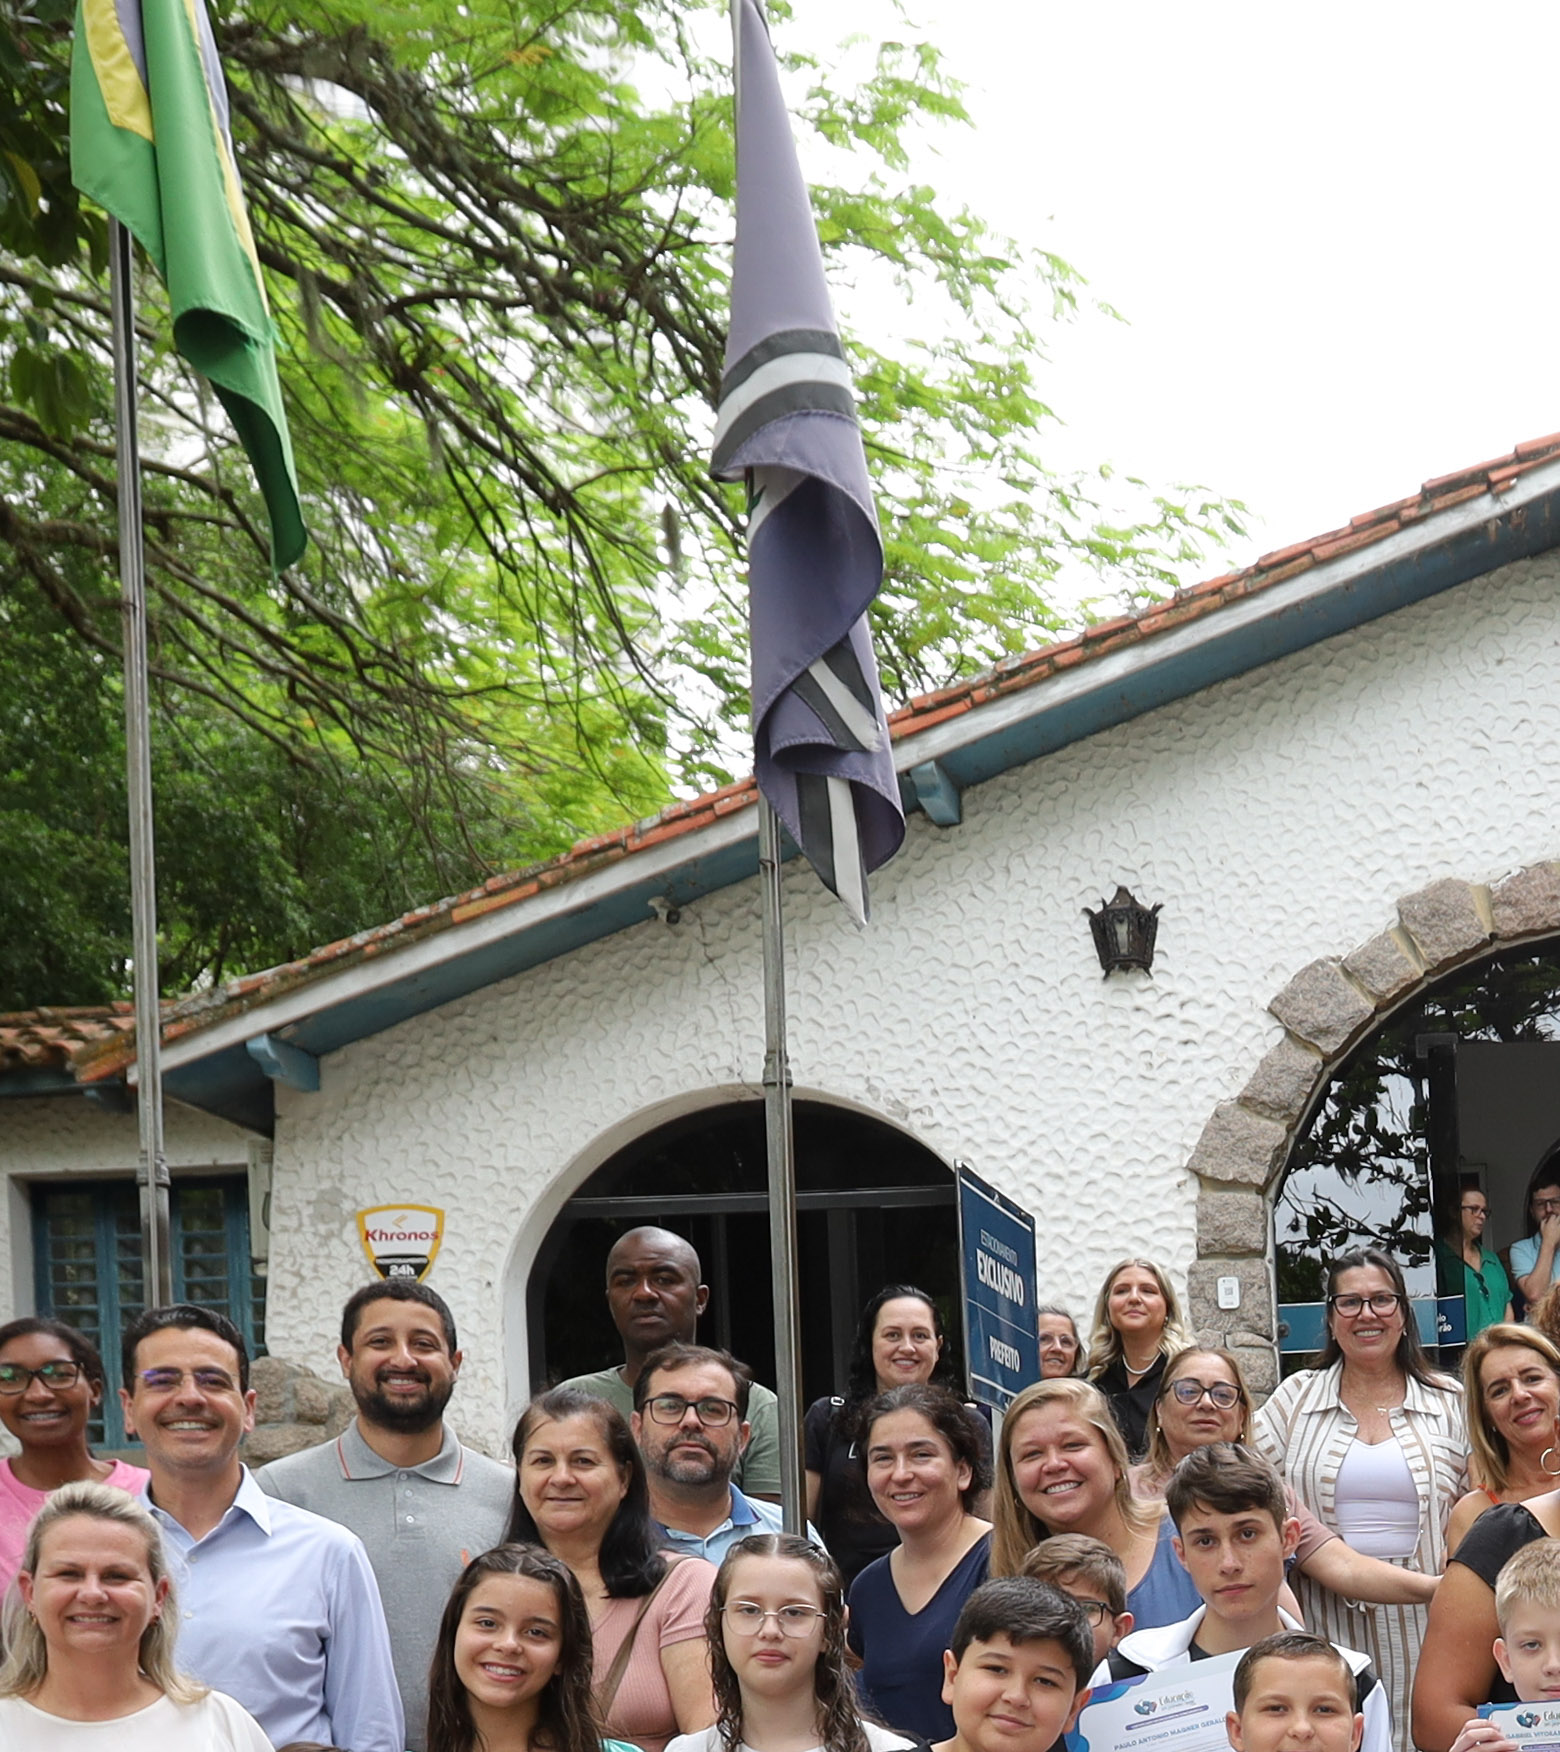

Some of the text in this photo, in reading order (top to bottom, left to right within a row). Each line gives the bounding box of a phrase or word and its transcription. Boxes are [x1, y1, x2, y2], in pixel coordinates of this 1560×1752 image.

[365, 1229, 439, 1242] Khronos
[389, 1264, 416, 1276] 24h
[976, 1248, 1025, 1307] EXCLUSIVO
[989, 1335, 1021, 1373] PREFEITO
